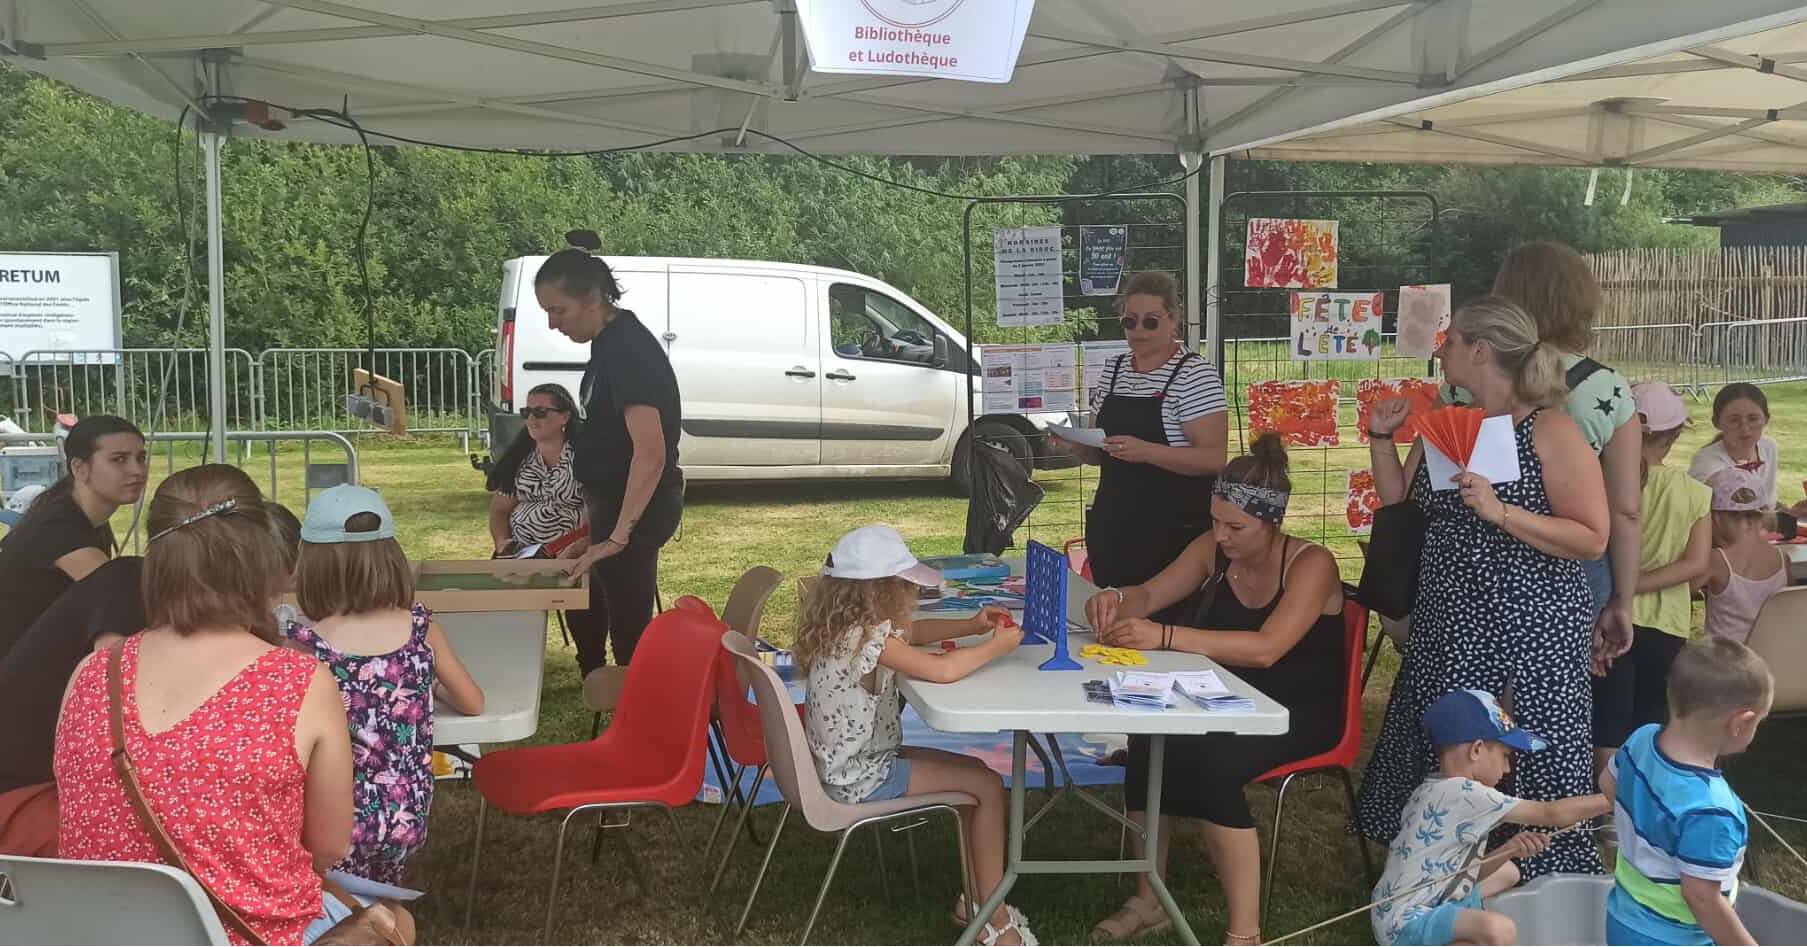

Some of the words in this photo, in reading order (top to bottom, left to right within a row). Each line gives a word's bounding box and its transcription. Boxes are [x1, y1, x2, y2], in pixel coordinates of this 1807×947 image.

[855, 26, 952, 47] Bibliothèque
[848, 50, 863, 62] et
[868, 50, 958, 69] Ludothèque
[0, 269, 61, 284] RETUM
[1297, 293, 1371, 323] FÊTE
